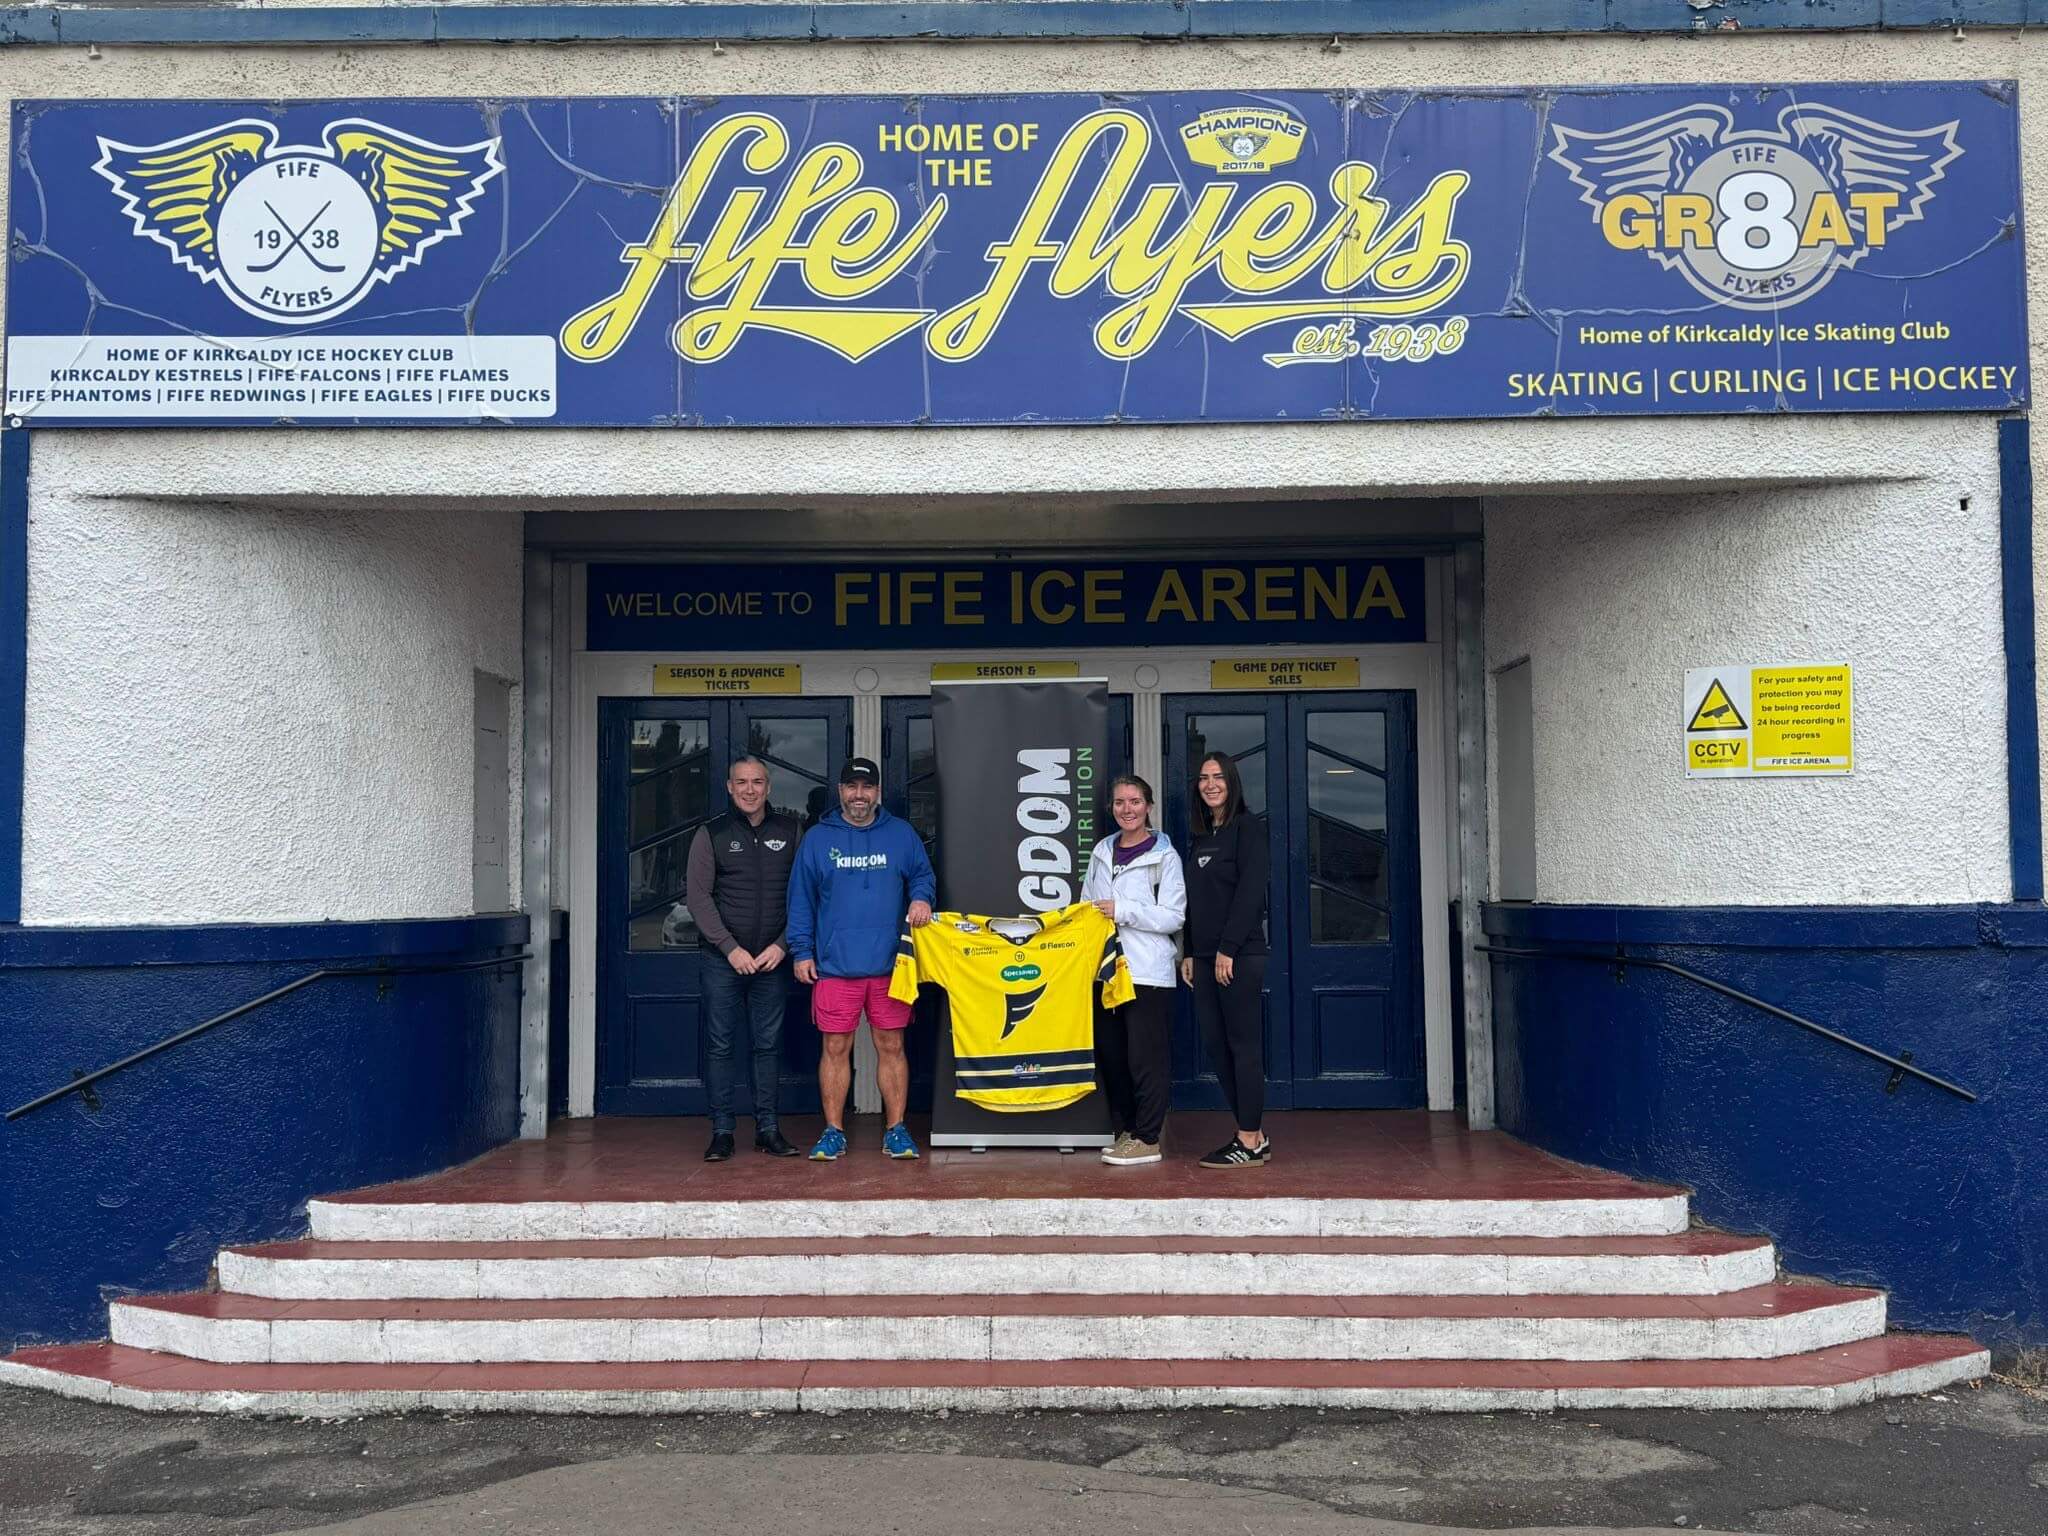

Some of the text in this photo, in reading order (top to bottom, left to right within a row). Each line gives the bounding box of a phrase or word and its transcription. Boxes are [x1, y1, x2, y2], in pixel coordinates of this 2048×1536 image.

[1185, 117, 1303, 139] CHAMPIONS
[879, 123, 1039, 152] HOME OF
[1732, 146, 1777, 165] FIFE
[276, 161, 320, 179] FIFE
[925, 159, 993, 187] THE
[1222, 162, 1265, 170] 2017/18
[253, 229, 340, 249] 19 38
[1723, 271, 1796, 296] FLYERS
[260, 286, 333, 308] FLYERS
[1364, 315, 1469, 362] 1938
[1580, 321, 1950, 346] Home of Kirkcaldy Ice Skating Club
[107, 348, 454, 362] HOME OF KIRKCALDY ICE HOCKEY CLUB
[50, 369, 510, 382] KIRKCALDY KESTRELS FIFE FALCONS FIFE FLAMES
[1507, 364, 2018, 398] SKATING CURLING ICE HOCKEY
[9, 389, 551, 402] FIFE PHANTOMS FIFE REDWINGS FIFE EAGLES FIFE DUCKS
[605, 565, 1407, 626] WELCOME TO FIFE ICE ARENA
[670, 668, 785, 678] SEASON & ADVANCE
[976, 666, 1036, 676] SEASON &
[1233, 661, 1337, 673] GAME DAY TICKET
[705, 680, 750, 690] TICKETS
[1268, 675, 1303, 685] SALES
[1758, 676, 1773, 684] For
[1797, 675, 1825, 684] safety
[1826, 674, 1843, 682] and
[1759, 690, 1843, 699] protection you may
[1761, 702, 1841, 712] be being recorded
[1769, 718, 1790, 726] hour
[1791, 717, 1835, 727] recording
[1781, 732, 1821, 741] progress
[1695, 742, 1741, 757] CCTV
[1803, 757, 1831, 765] ARENA
[1016, 748, 1072, 913] GDOM
